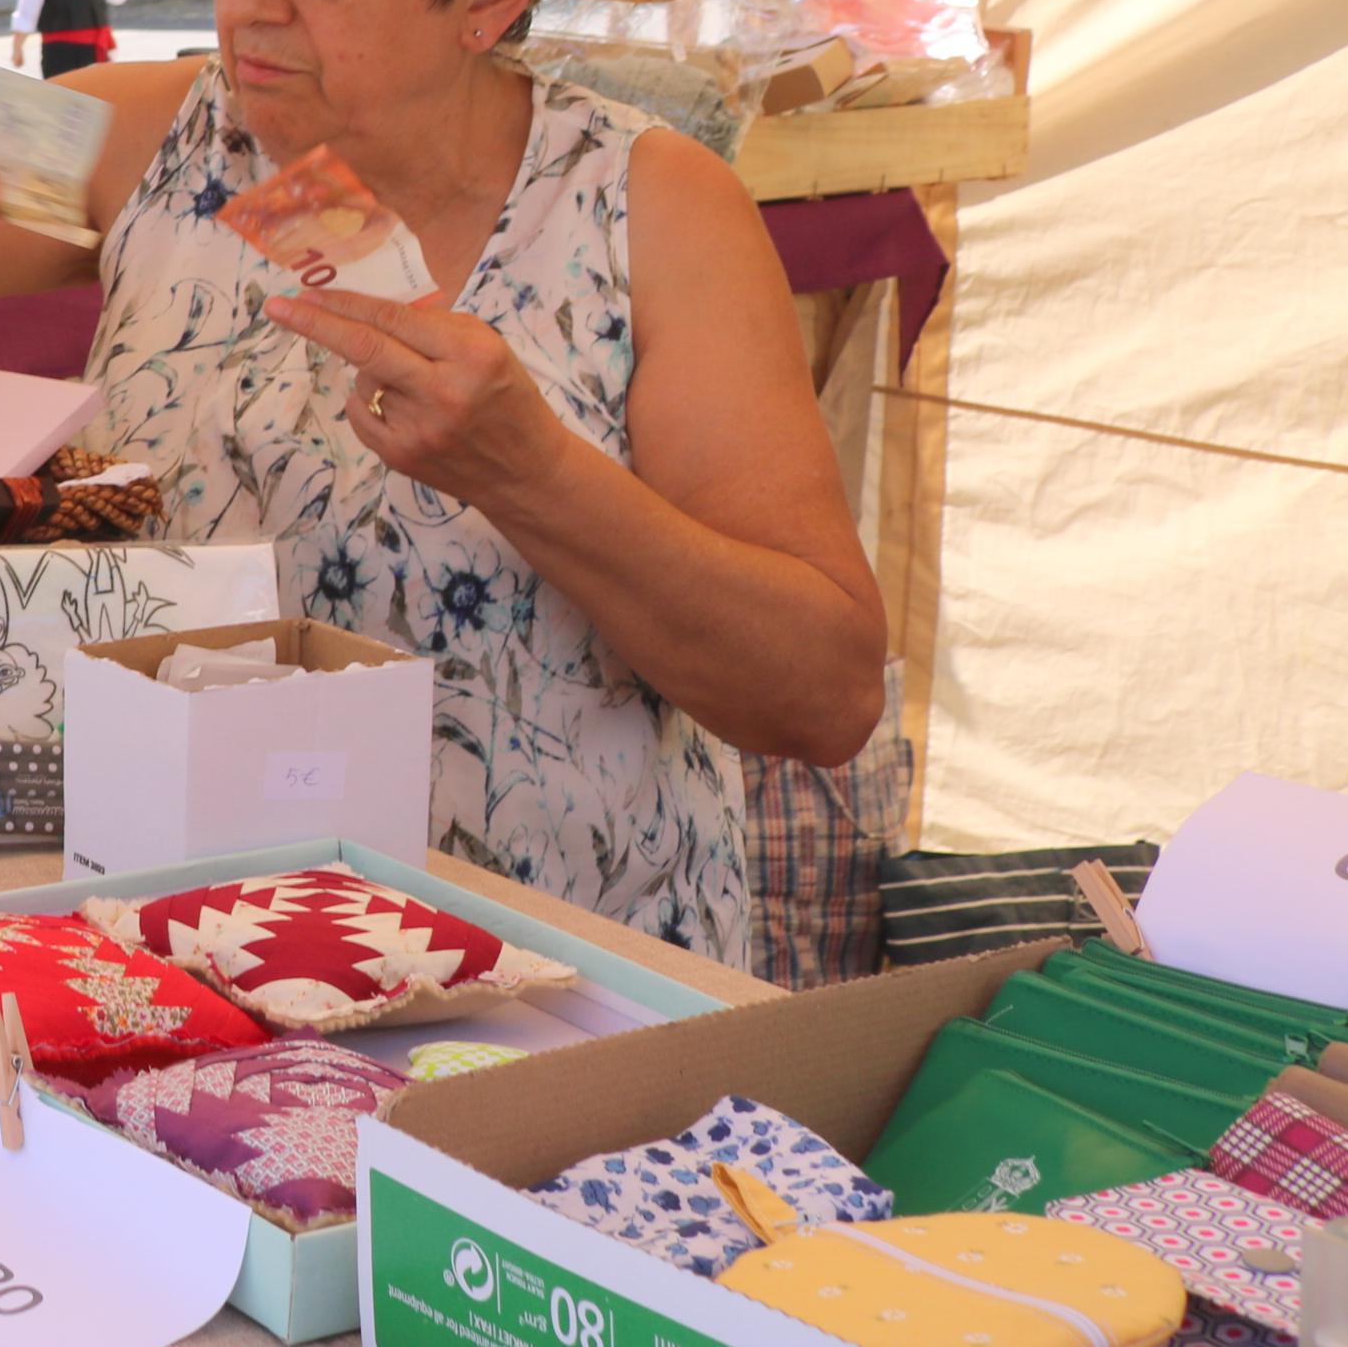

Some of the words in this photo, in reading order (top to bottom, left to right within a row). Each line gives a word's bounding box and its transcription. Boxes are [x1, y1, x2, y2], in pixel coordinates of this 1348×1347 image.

[290, 248, 337, 288] 10
[286, 766, 321, 788] 5€
[388, 1283, 433, 1319] equipment
[474, 1313, 492, 1337] FAX
